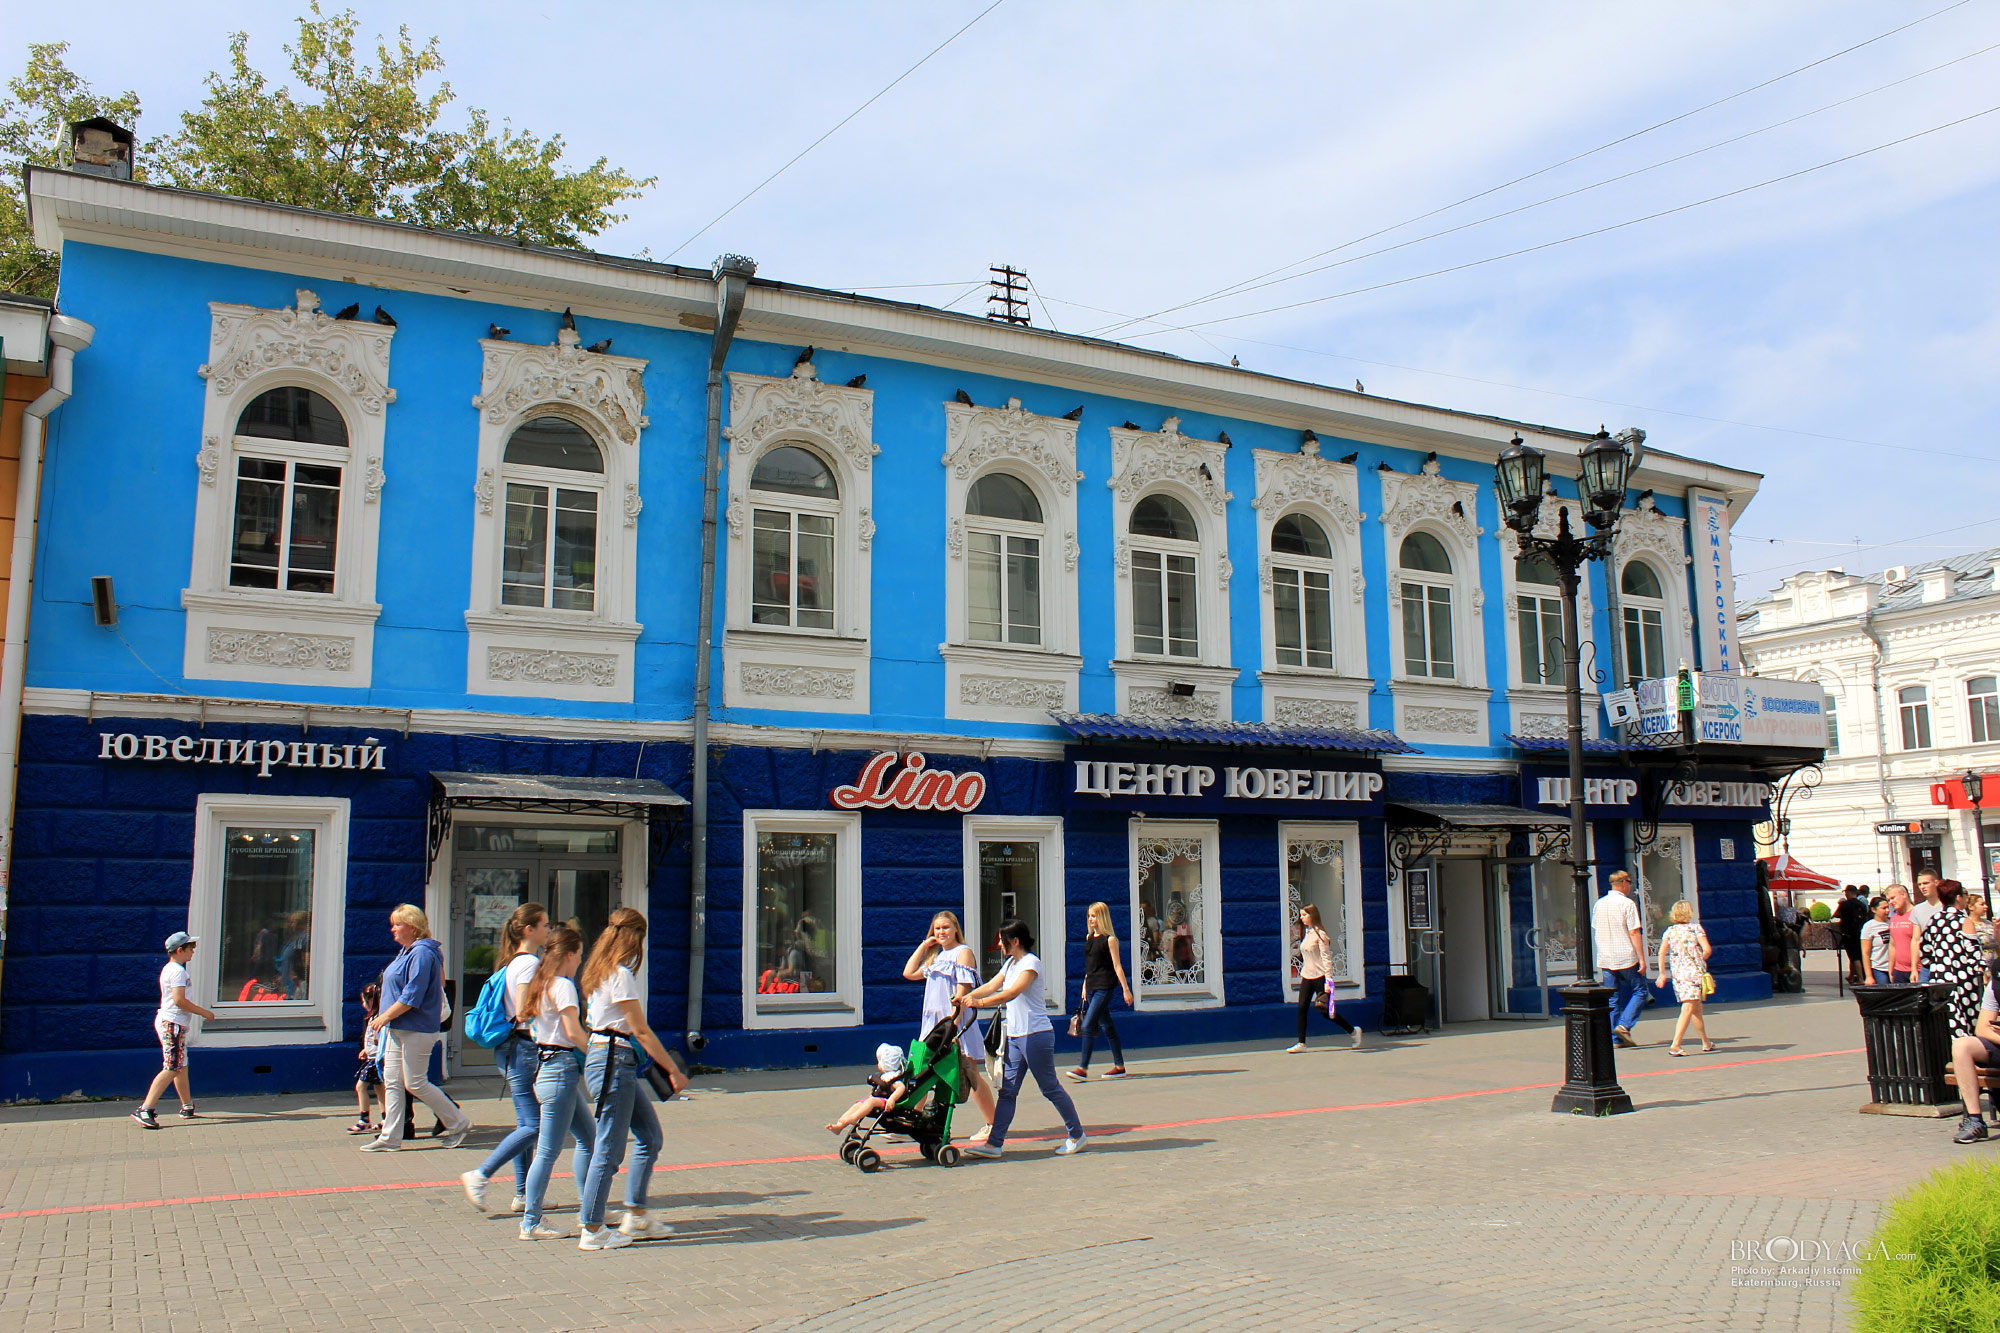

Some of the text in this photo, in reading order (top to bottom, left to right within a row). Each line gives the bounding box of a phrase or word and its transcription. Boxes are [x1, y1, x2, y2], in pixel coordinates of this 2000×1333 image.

[1710, 533, 1730, 673] МАТРОСКИН
[1640, 680, 1677, 705] ФОТО
[1700, 677, 1738, 702] ФОТО
[1761, 696, 1820, 715] ЗООМАГАЗИН
[1641, 713, 1676, 734] КСЕРОКС
[1703, 721, 1741, 740] КСЕРОКС
[1744, 718, 1822, 736] МАТРОСКИН
[829, 751, 987, 812] Lino
[1074, 760, 1384, 802] ЦЕНТР ЮВЕЛИР
[1537, 776, 1638, 807] ЦНТР
[1877, 824, 1906, 832] Winline
